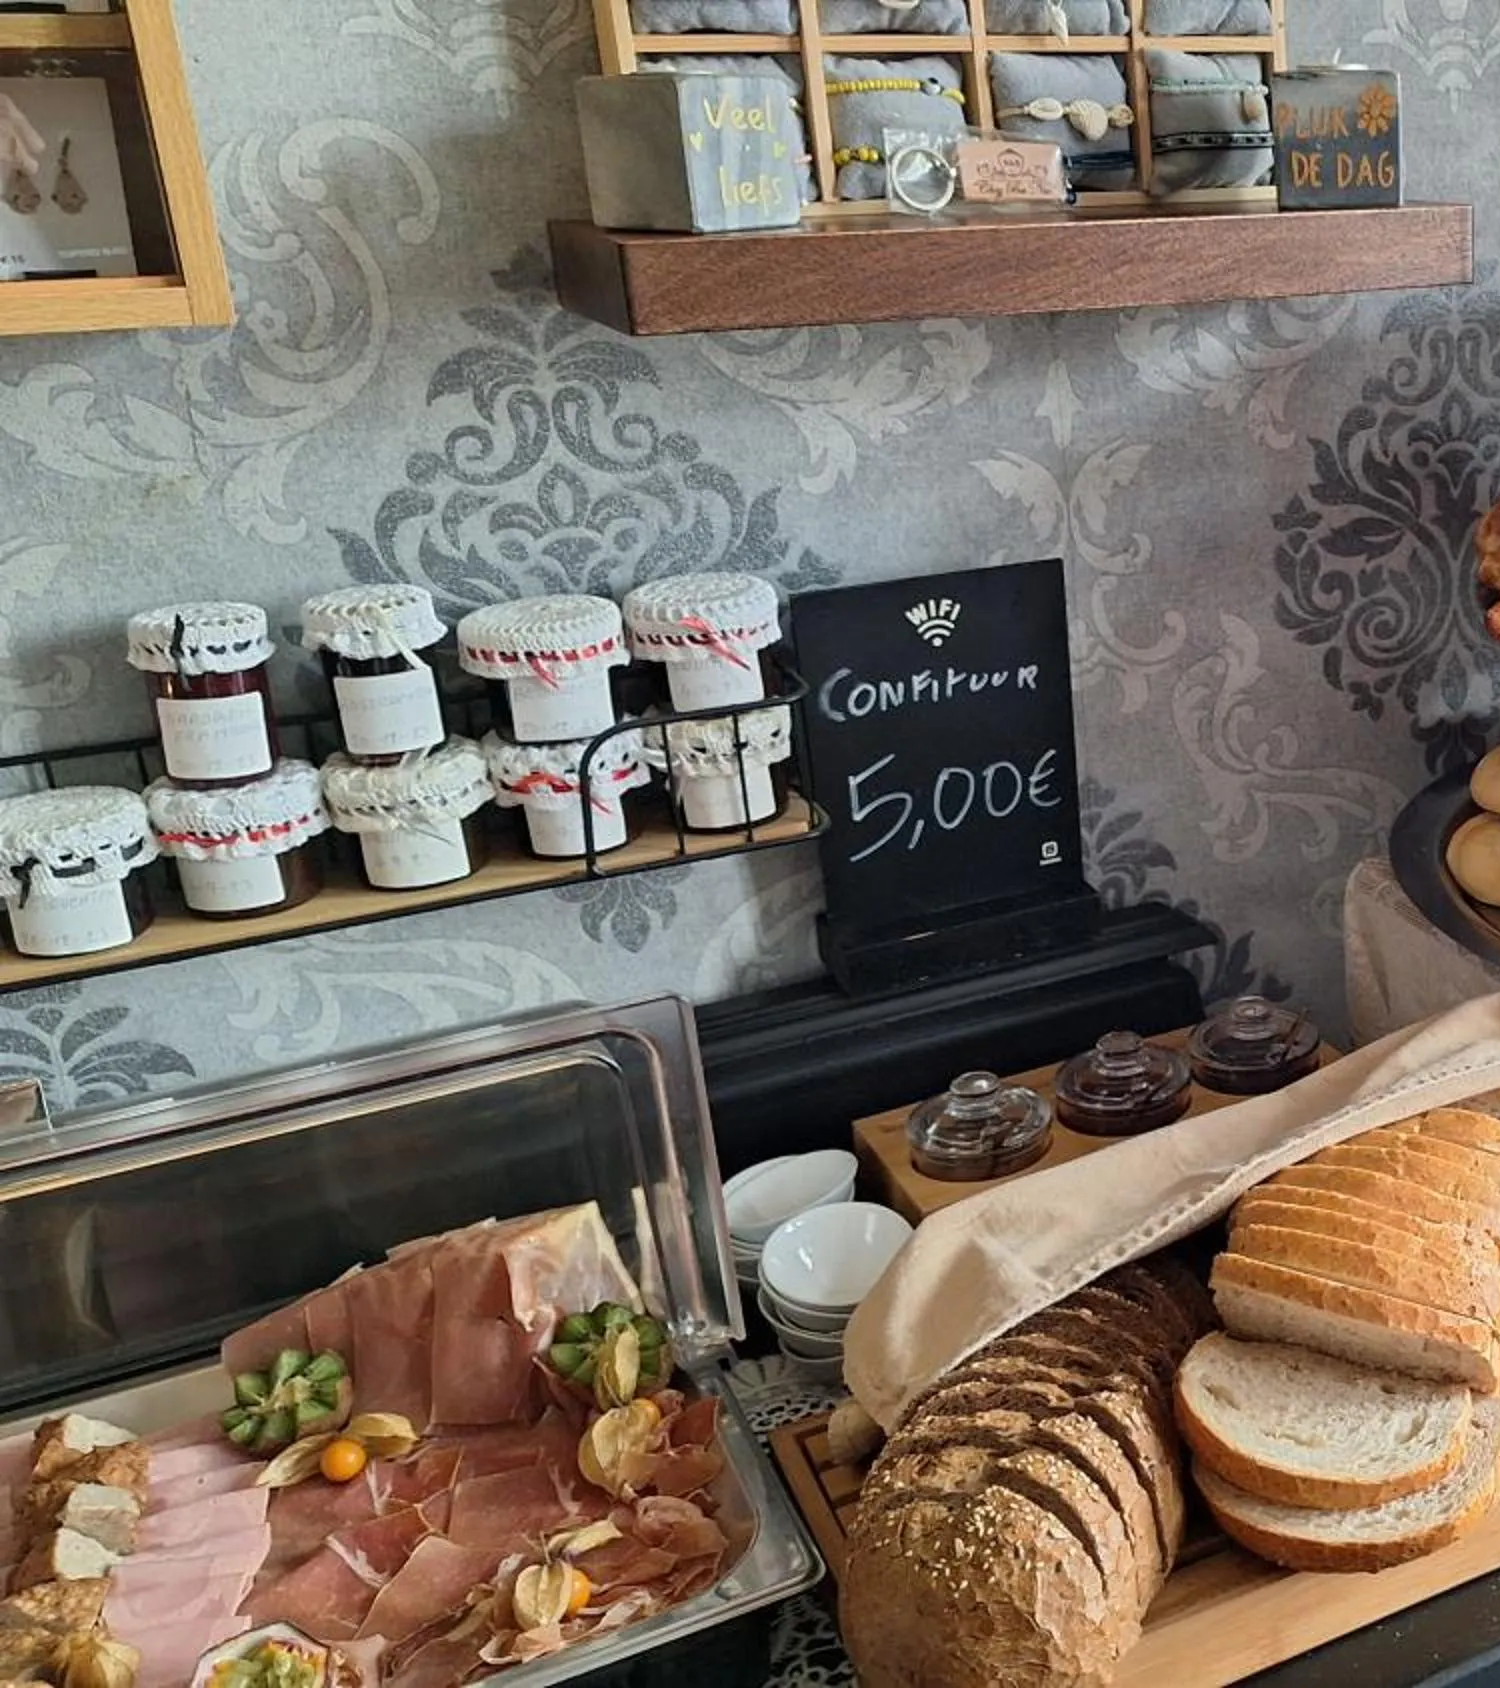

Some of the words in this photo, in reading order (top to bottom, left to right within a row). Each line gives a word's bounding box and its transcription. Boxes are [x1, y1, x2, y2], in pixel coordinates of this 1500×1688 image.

[703, 94, 775, 133] Veel
[1277, 101, 1350, 140] PLUK
[1290, 150, 1323, 188] DE
[1336, 150, 1395, 189] DAG
[905, 598, 961, 626] WIFI
[848, 748, 1062, 862] 5,00€
